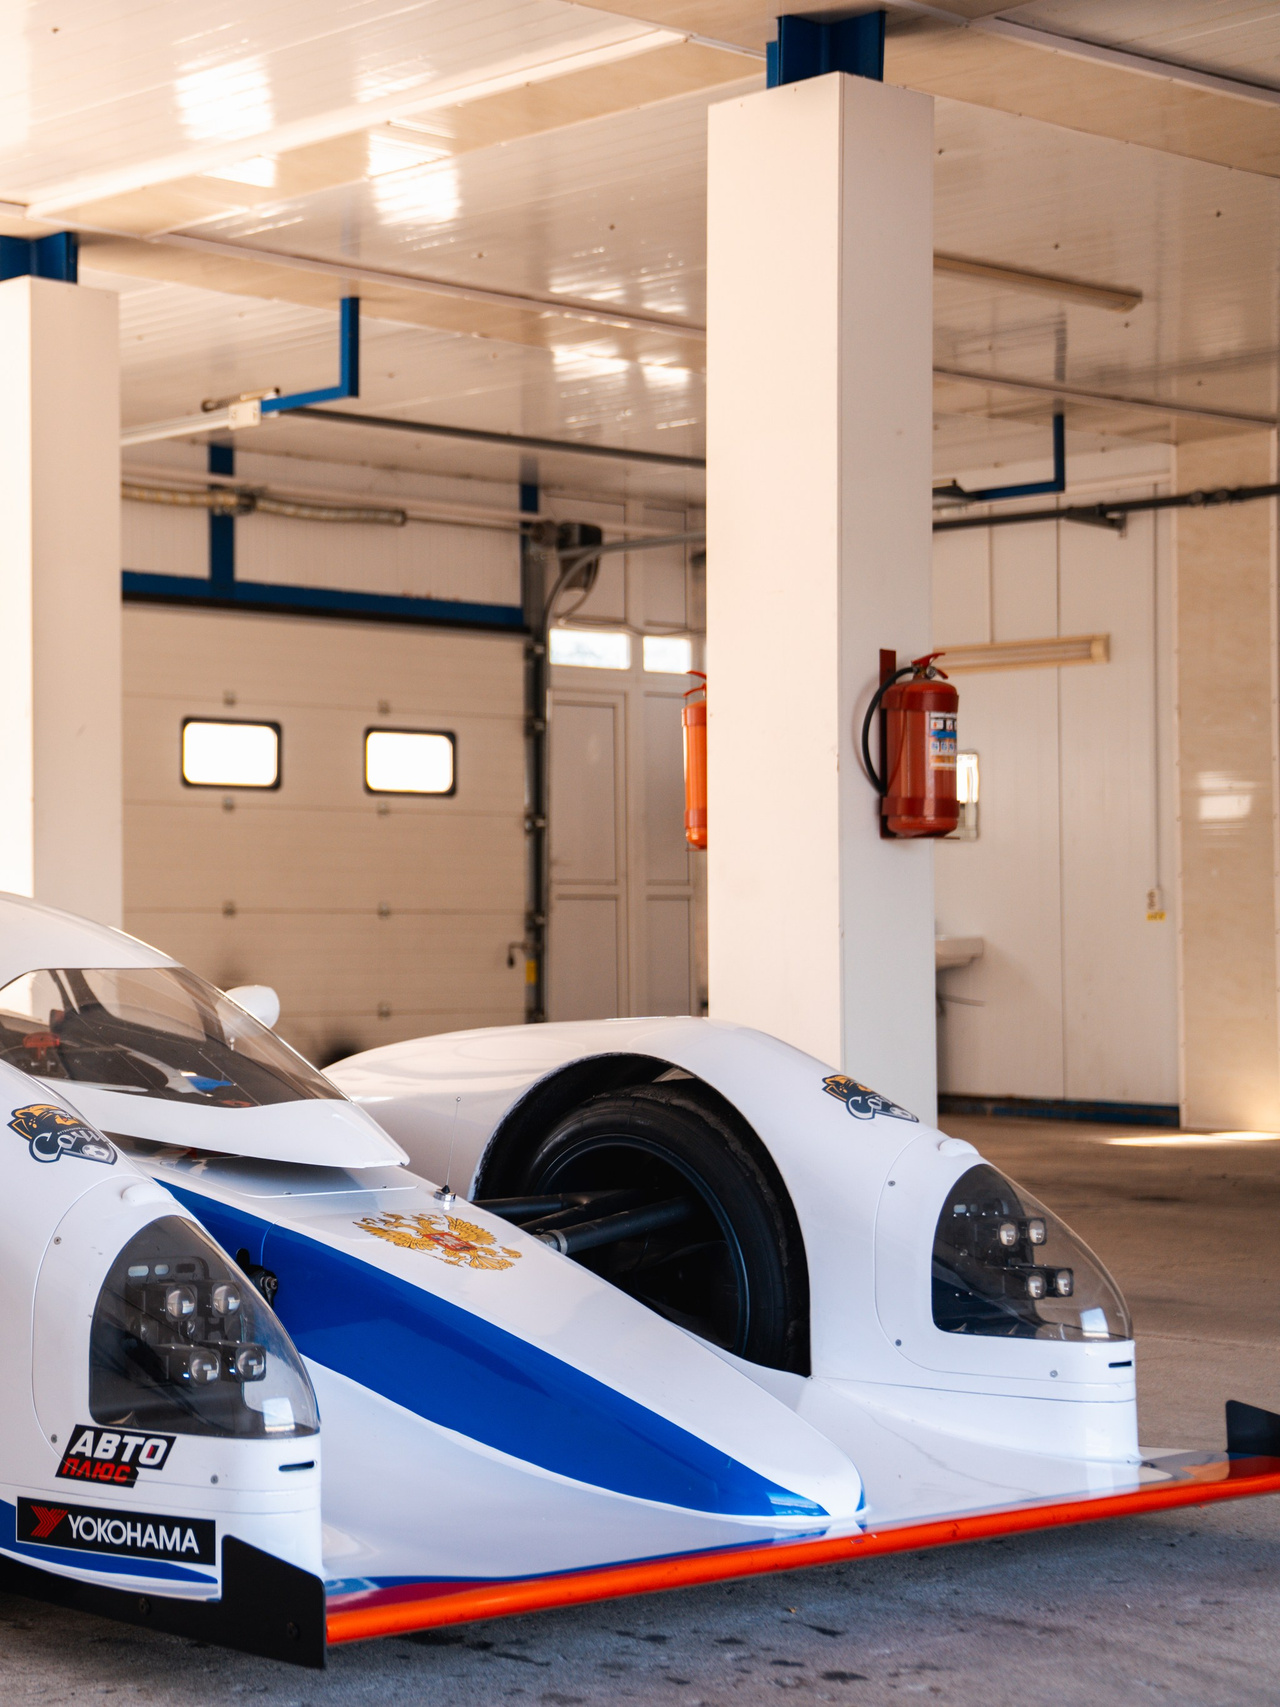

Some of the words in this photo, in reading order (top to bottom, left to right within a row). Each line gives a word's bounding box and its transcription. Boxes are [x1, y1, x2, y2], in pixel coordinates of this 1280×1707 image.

[69, 1430, 168, 1466] АВТО
[61, 1458, 131, 1483] ПЛЮС
[68, 1513, 200, 1555] YOKOHAMA
